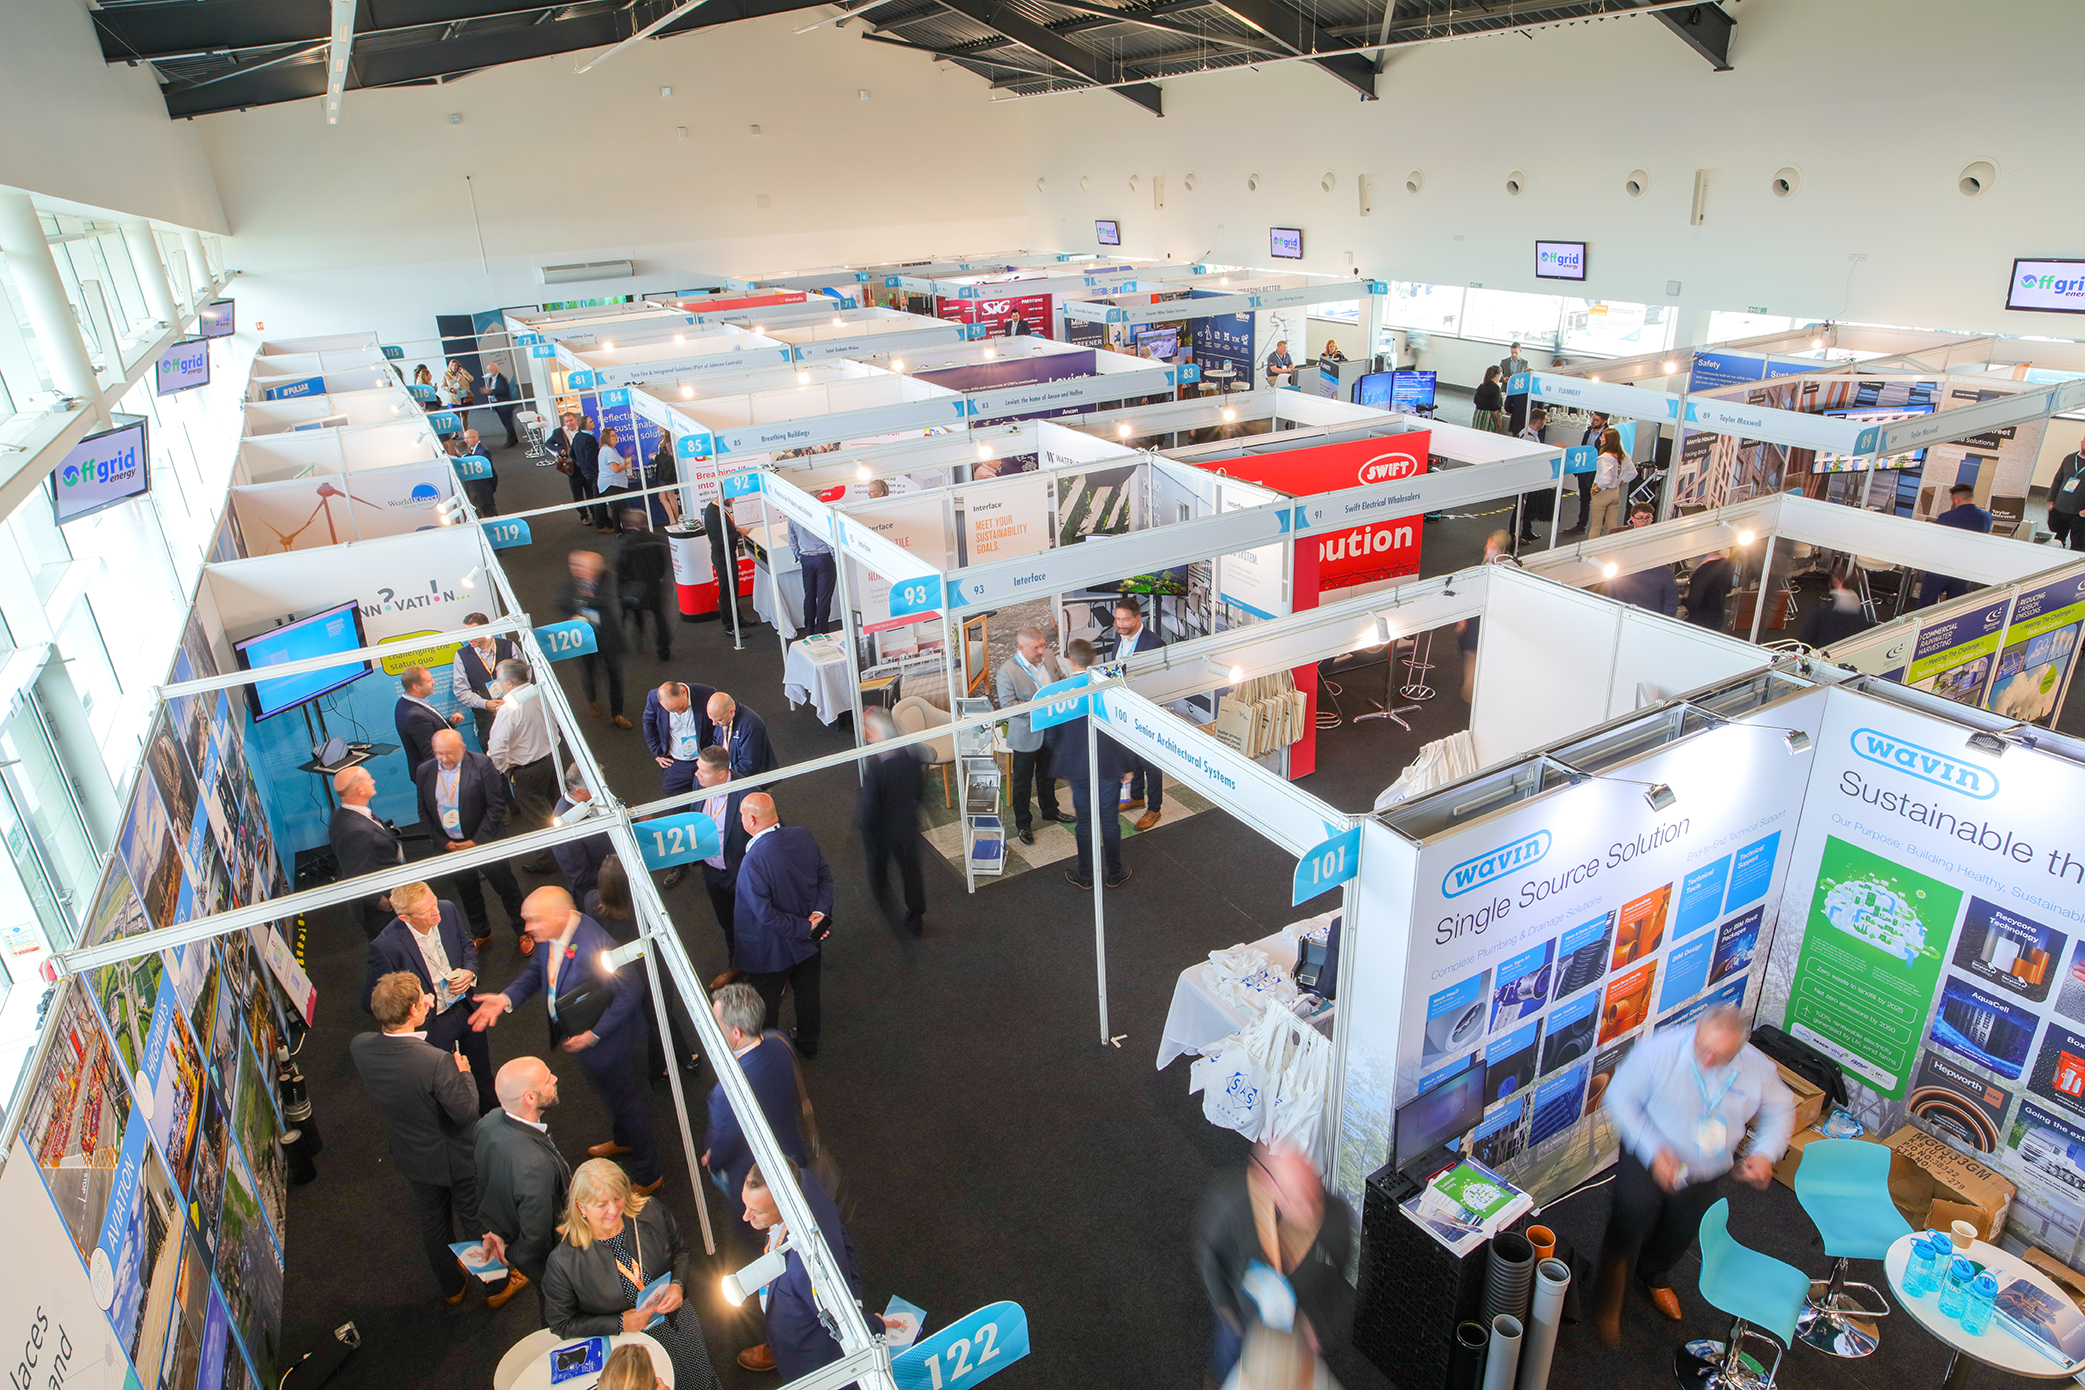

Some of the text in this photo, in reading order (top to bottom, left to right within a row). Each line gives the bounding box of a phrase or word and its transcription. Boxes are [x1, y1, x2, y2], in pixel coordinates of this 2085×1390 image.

[1262, 284, 1281, 292] BETTER
[1110, 311, 1117, 319] 77
[972, 326, 981, 335] 79
[522, 337, 532, 345] 73
[386, 348, 399, 357] 115
[539, 346, 549, 355] 80
[187, 367, 204, 376] energy
[652, 367, 674, 376] Integrated
[1698, 359, 1721, 370] Safety
[575, 374, 585, 384] 81
[1183, 368, 1194, 379] 83
[287, 383, 309, 396] PULSAR
[1514, 378, 1525, 390] 88
[1545, 385, 1582, 397] 88 FLANNERY
[413, 388, 429, 398] 116
[610, 391, 622, 402] 84
[435, 417, 453, 429] 117
[1702, 411, 1763, 427] 89 Taylor Maxwell
[734, 430, 810, 447] 85 Breathing Buildings
[1701, 434, 1716, 443] House
[1911, 425, 1939, 439] Taylor Maxwell
[687, 440, 702, 453] 85
[1862, 434, 1873, 448] 89
[1966, 437, 1995, 447] Solutions
[461, 460, 484, 475] 118
[1575, 451, 1588, 467] 91
[109, 467, 137, 483] energy
[1366, 460, 1410, 480] SWIFT
[733, 475, 750, 491] 92
[973, 501, 1002, 512] Interface
[1314, 492, 1421, 520] 91 Swift Electrical Wholesalers
[975, 514, 1013, 530] MEET YOUR
[494, 524, 519, 542] 119
[976, 523, 1028, 543] SUSTAINABILITY
[976, 542, 1000, 555] GOALS.
[973, 571, 1047, 595] 93 Interface
[904, 585, 927, 606] 93
[2020, 592, 2047, 605] REDUCING
[2015, 606, 2042, 621] EMISSIONS
[2018, 601, 2040, 613] CARBON
[2024, 609, 2072, 629] Meeting Challenge
[1919, 631, 1953, 648] RAINWATER
[1922, 622, 1958, 640] COMMERCIAL
[547, 628, 583, 653] 120
[1918, 638, 1953, 656] HARVESTING
[390, 656, 435, 671] status quo
[1927, 643, 1980, 667] Meeting The Challenge
[1944, 658, 1960, 669] Global
[1960, 653, 1973, 663] Water
[1974, 647, 1987, 659] Crisis
[1114, 705, 1128, 723] 100
[1134, 718, 1156, 741] Senior
[1157, 729, 1202, 769] Architectural
[1203, 760, 1236, 790] Systems
[1866, 735, 1980, 792] wavin
[1839, 770, 2034, 865] Sustainable
[652, 824, 698, 857] 121
[1686, 809, 1787, 863] End-to-End Technical Support
[1739, 844, 1765, 860] Technical
[1831, 812, 2007, 894] Our Purpose: Building Healthy,
[1312, 845, 1345, 884] 101
[1454, 836, 1540, 889] wavin
[1737, 854, 1759, 869] Support
[1435, 896, 1511, 945] Single
[1519, 857, 1600, 909] Source
[1606, 817, 1690, 870] Solution
[1687, 869, 1715, 886] Technical
[1686, 882, 1702, 894] Tools
[1723, 913, 1758, 935] Our BIM Revit
[1989, 917, 2040, 944] Technology
[1995, 911, 2038, 934] Recycore
[1431, 955, 1475, 980] Complete
[1477, 934, 1518, 960] Plumbing
[1519, 930, 1526, 941] &
[1527, 912, 1565, 937] Drainage
[1566, 896, 1603, 919] Solutions
[1722, 927, 1747, 942] Packages
[1672, 943, 1703, 963] BIM Design
[1816, 965, 1904, 1014] Zero waste landfill by 2025
[1813, 987, 1896, 1034] Net zero emissions by 2050
[1971, 991, 2010, 1013] AquaCell
[148, 997, 169, 1080] HIGHWAYS
[1812, 1016, 1897, 1066] generated by UK wind farms
[1815, 1009, 1893, 1056] 100% renewable electricity
[1933, 1060, 1983, 1092] Hepworth
[2024, 1106, 2051, 1125] Going
[2053, 1121, 2068, 1133] the
[1912, 1132, 1993, 1181] MG0333GM
[107, 1151, 136, 1255] AVIATION
[924, 1322, 1000, 1390] 122
